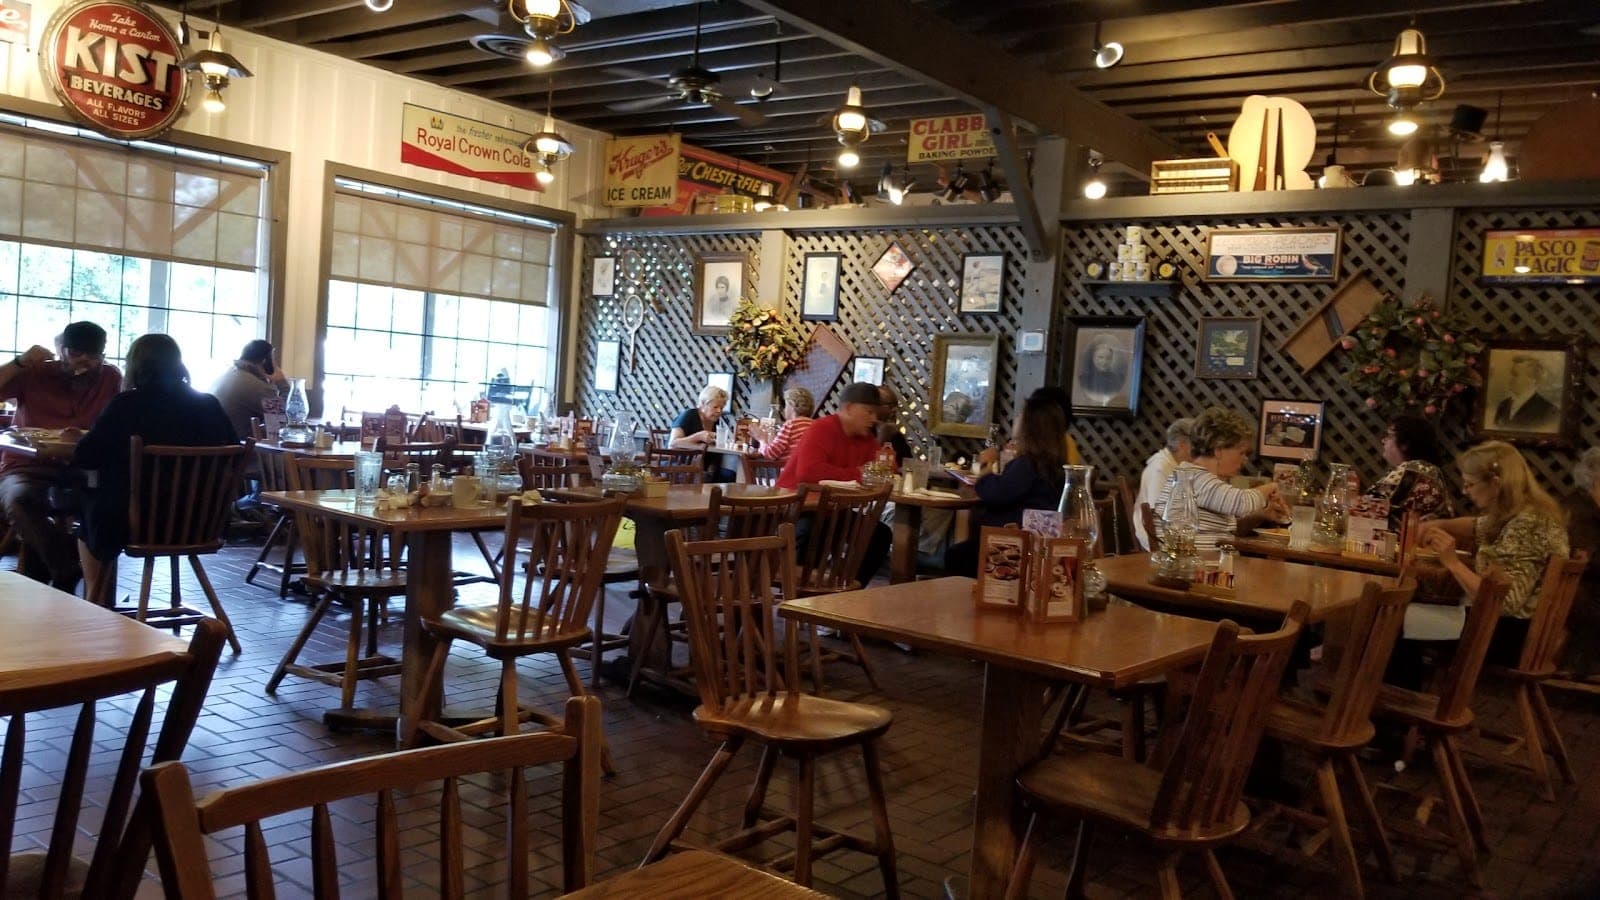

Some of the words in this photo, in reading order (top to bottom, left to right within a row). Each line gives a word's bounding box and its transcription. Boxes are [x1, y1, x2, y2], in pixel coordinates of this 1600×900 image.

[110, 13, 137, 27] Take
[89, 19, 118, 33] Home
[128, 28, 161, 42] Carton
[64, 26, 176, 92] KIST
[70, 75, 163, 111] BEVERAGES
[86, 98, 104, 109] ALL
[107, 103, 146, 119] FLAVORS
[92, 108, 109, 118] ALL
[112, 113, 139, 126] SIZES
[416, 127, 456, 151] Royal
[458, 137, 500, 162] Crown
[503, 148, 531, 169] Cola
[922, 134, 972, 151] GIRL
[918, 150, 957, 160] BAKING
[607, 187, 625, 201] ICE
[631, 186, 672, 201] CREAM
[1515, 240, 1576, 256] PASCO
[1242, 255, 1262, 263] BIG
[1264, 255, 1299, 263] ROBIN
